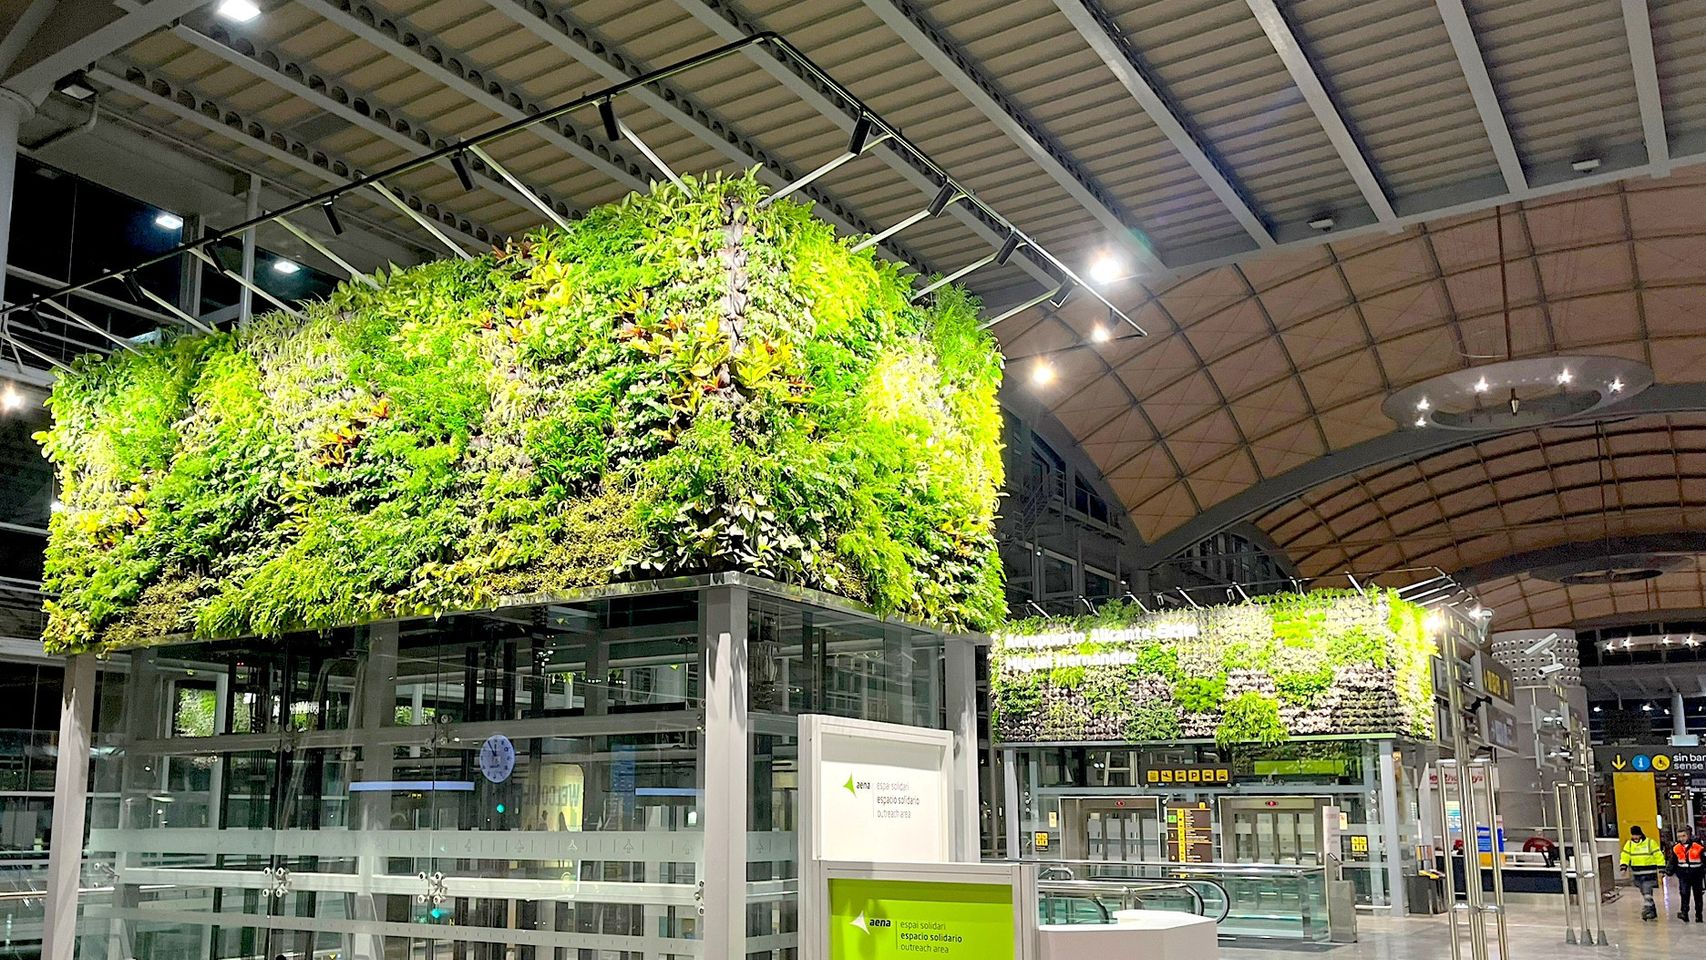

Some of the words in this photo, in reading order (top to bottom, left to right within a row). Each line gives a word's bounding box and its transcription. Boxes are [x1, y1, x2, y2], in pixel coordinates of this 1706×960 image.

[1005, 632, 1085, 650] Aeropuerto
[1006, 655, 1052, 672] Miguel
[1673, 752, 1688, 762] sin
[856, 781, 871, 790] aena
[877, 782, 890, 791] espai
[877, 796, 897, 806] espacio
[898, 796, 920, 805] solidario
[900, 810, 911, 818] area
[869, 918, 891, 927] aena
[900, 920, 919, 930] espai
[920, 921, 946, 930] solidari
[900, 932, 929, 941] espacio
[930, 933, 963, 943] solidario
[900, 943, 932, 952] outreach
[933, 945, 949, 954] area
